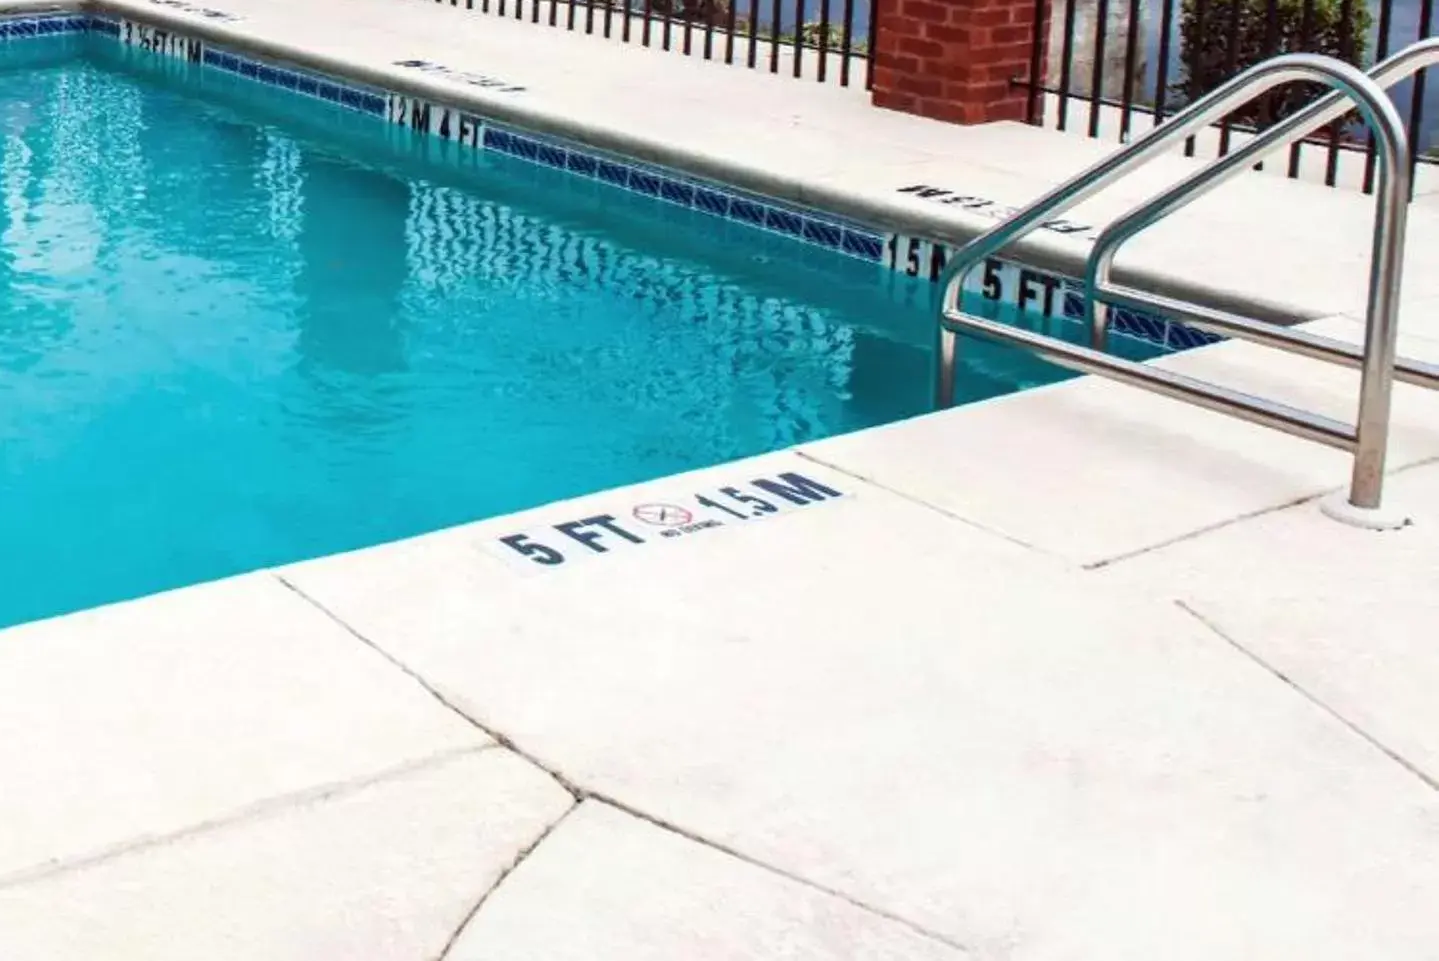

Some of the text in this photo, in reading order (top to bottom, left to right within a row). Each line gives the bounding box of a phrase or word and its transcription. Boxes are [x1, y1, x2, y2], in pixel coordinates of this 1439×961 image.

[459, 112, 481, 148] FT
[981, 257, 1003, 301] 5
[1018, 268, 1063, 318] FT
[498, 533, 566, 566] 5
[552, 514, 646, 554] FT
